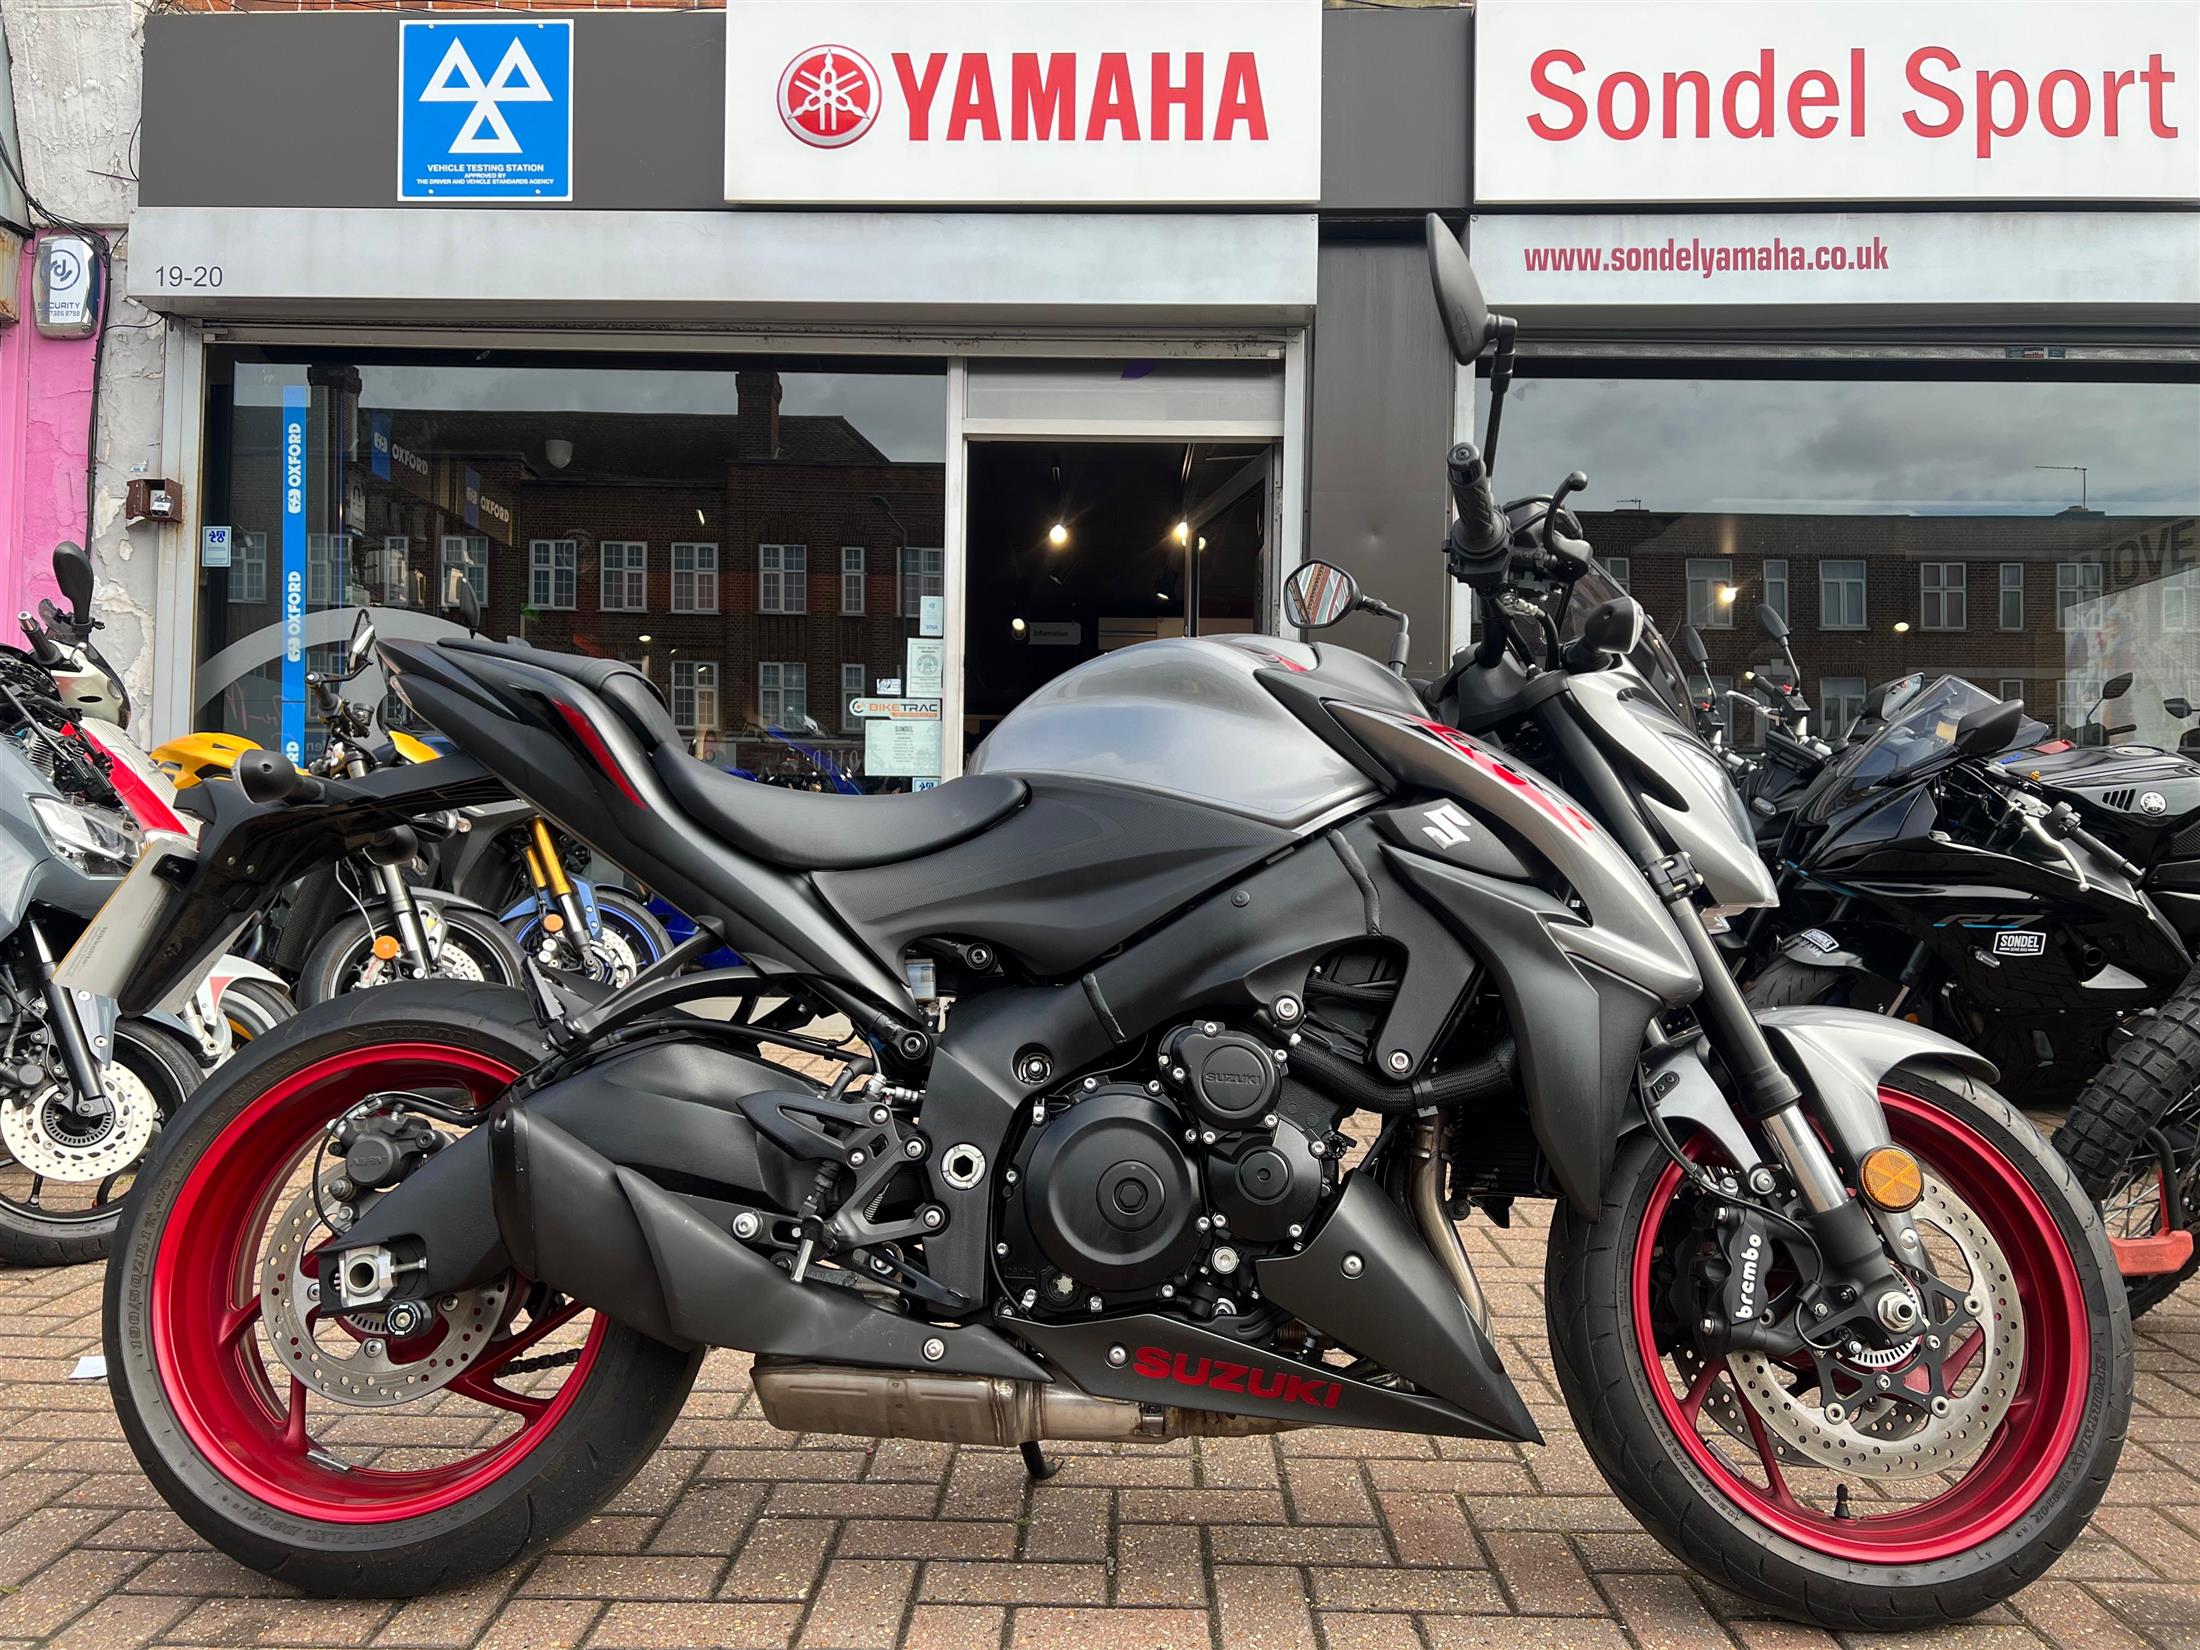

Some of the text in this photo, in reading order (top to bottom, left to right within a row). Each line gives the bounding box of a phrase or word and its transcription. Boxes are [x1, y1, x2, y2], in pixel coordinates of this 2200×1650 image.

[891, 52, 1269, 141] YAMAHA
[1526, 45, 2179, 159] Sondel Sport
[427, 164, 544, 172] VEHICLE TESTING STATION
[1523, 236, 1889, 279] www.sondelyamaha.co.uk
[155, 265, 223, 287] 19-20
[287, 422, 301, 487] OXFORD
[391, 443, 429, 475] OXFORD
[480, 495, 510, 523] OXFORD
[287, 571, 301, 636] OXFORD
[869, 703, 938, 712] BIKETRAC
[1932, 913, 2045, 929] R7
[2000, 935, 2040, 948] SONDEL
[1204, 1072, 1261, 1086] SUZUKI
[1734, 1234, 1762, 1319] brembo
[1132, 1346, 1344, 1409] SUZUKI
